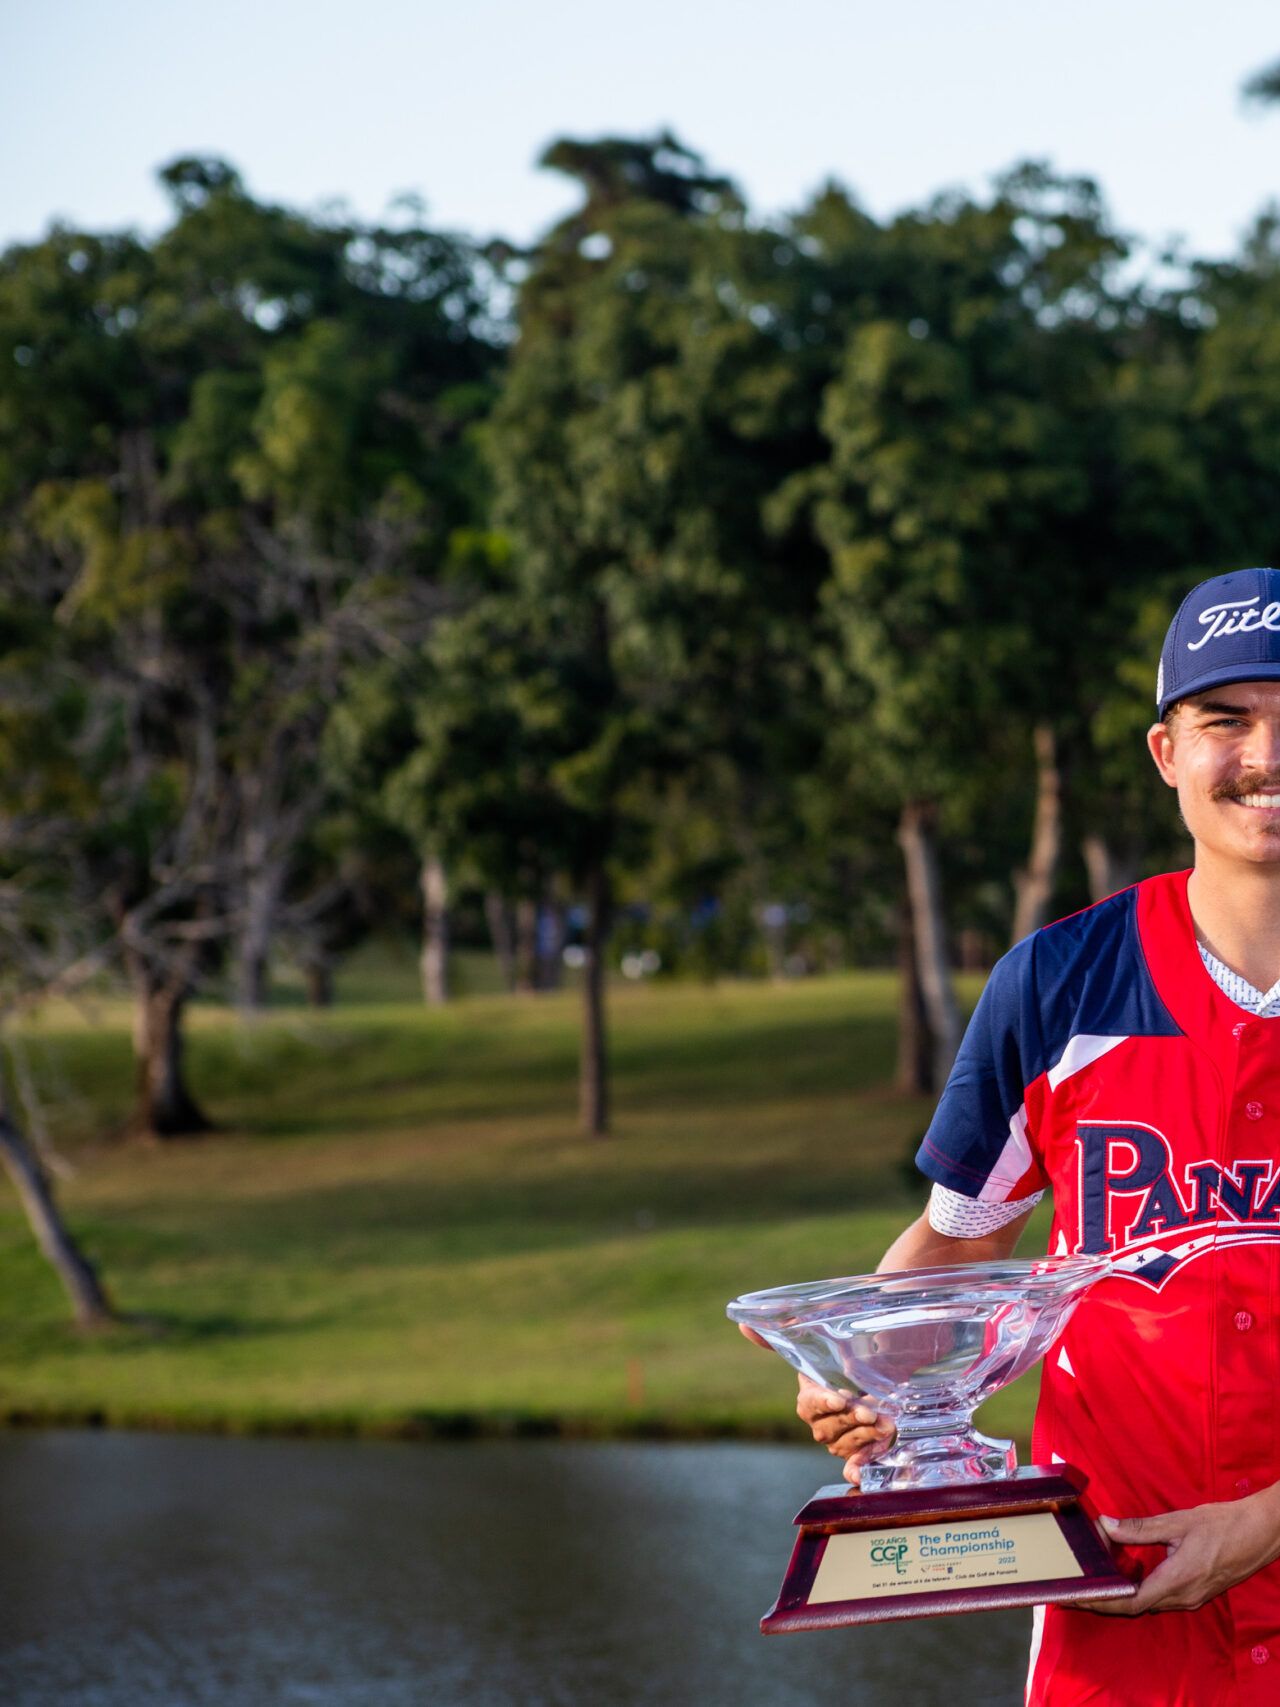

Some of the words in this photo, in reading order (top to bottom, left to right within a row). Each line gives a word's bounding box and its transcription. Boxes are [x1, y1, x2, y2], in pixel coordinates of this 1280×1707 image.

[918, 1534, 941, 1546] The
[945, 1526, 1000, 1542] Panamá
[870, 1544, 908, 1563] CGP
[919, 1539, 1015, 1557] Championship
